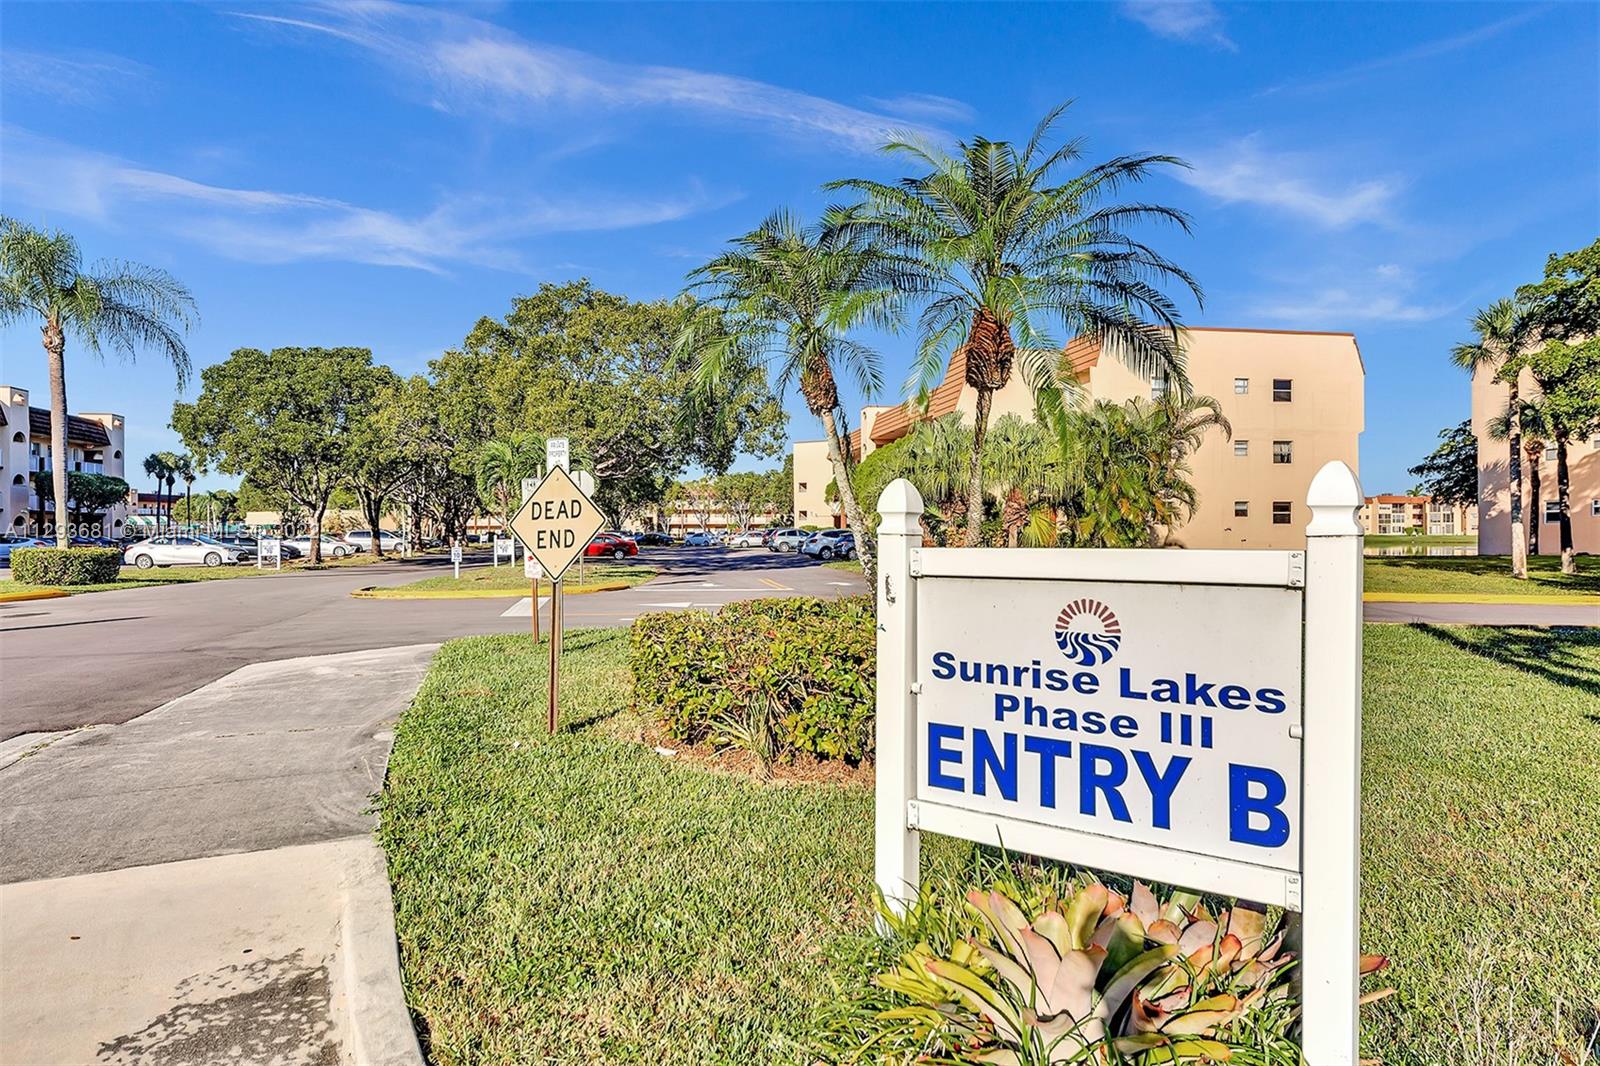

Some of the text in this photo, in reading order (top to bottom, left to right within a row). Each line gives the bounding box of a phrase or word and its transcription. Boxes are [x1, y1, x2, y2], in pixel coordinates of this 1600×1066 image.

[531, 499, 582, 521] DEAD
[537, 528, 576, 550] END
[931, 651, 1288, 715] Sunrise Lakes
[994, 692, 1214, 749] Phase III
[927, 721, 1291, 849] ENTRY B
